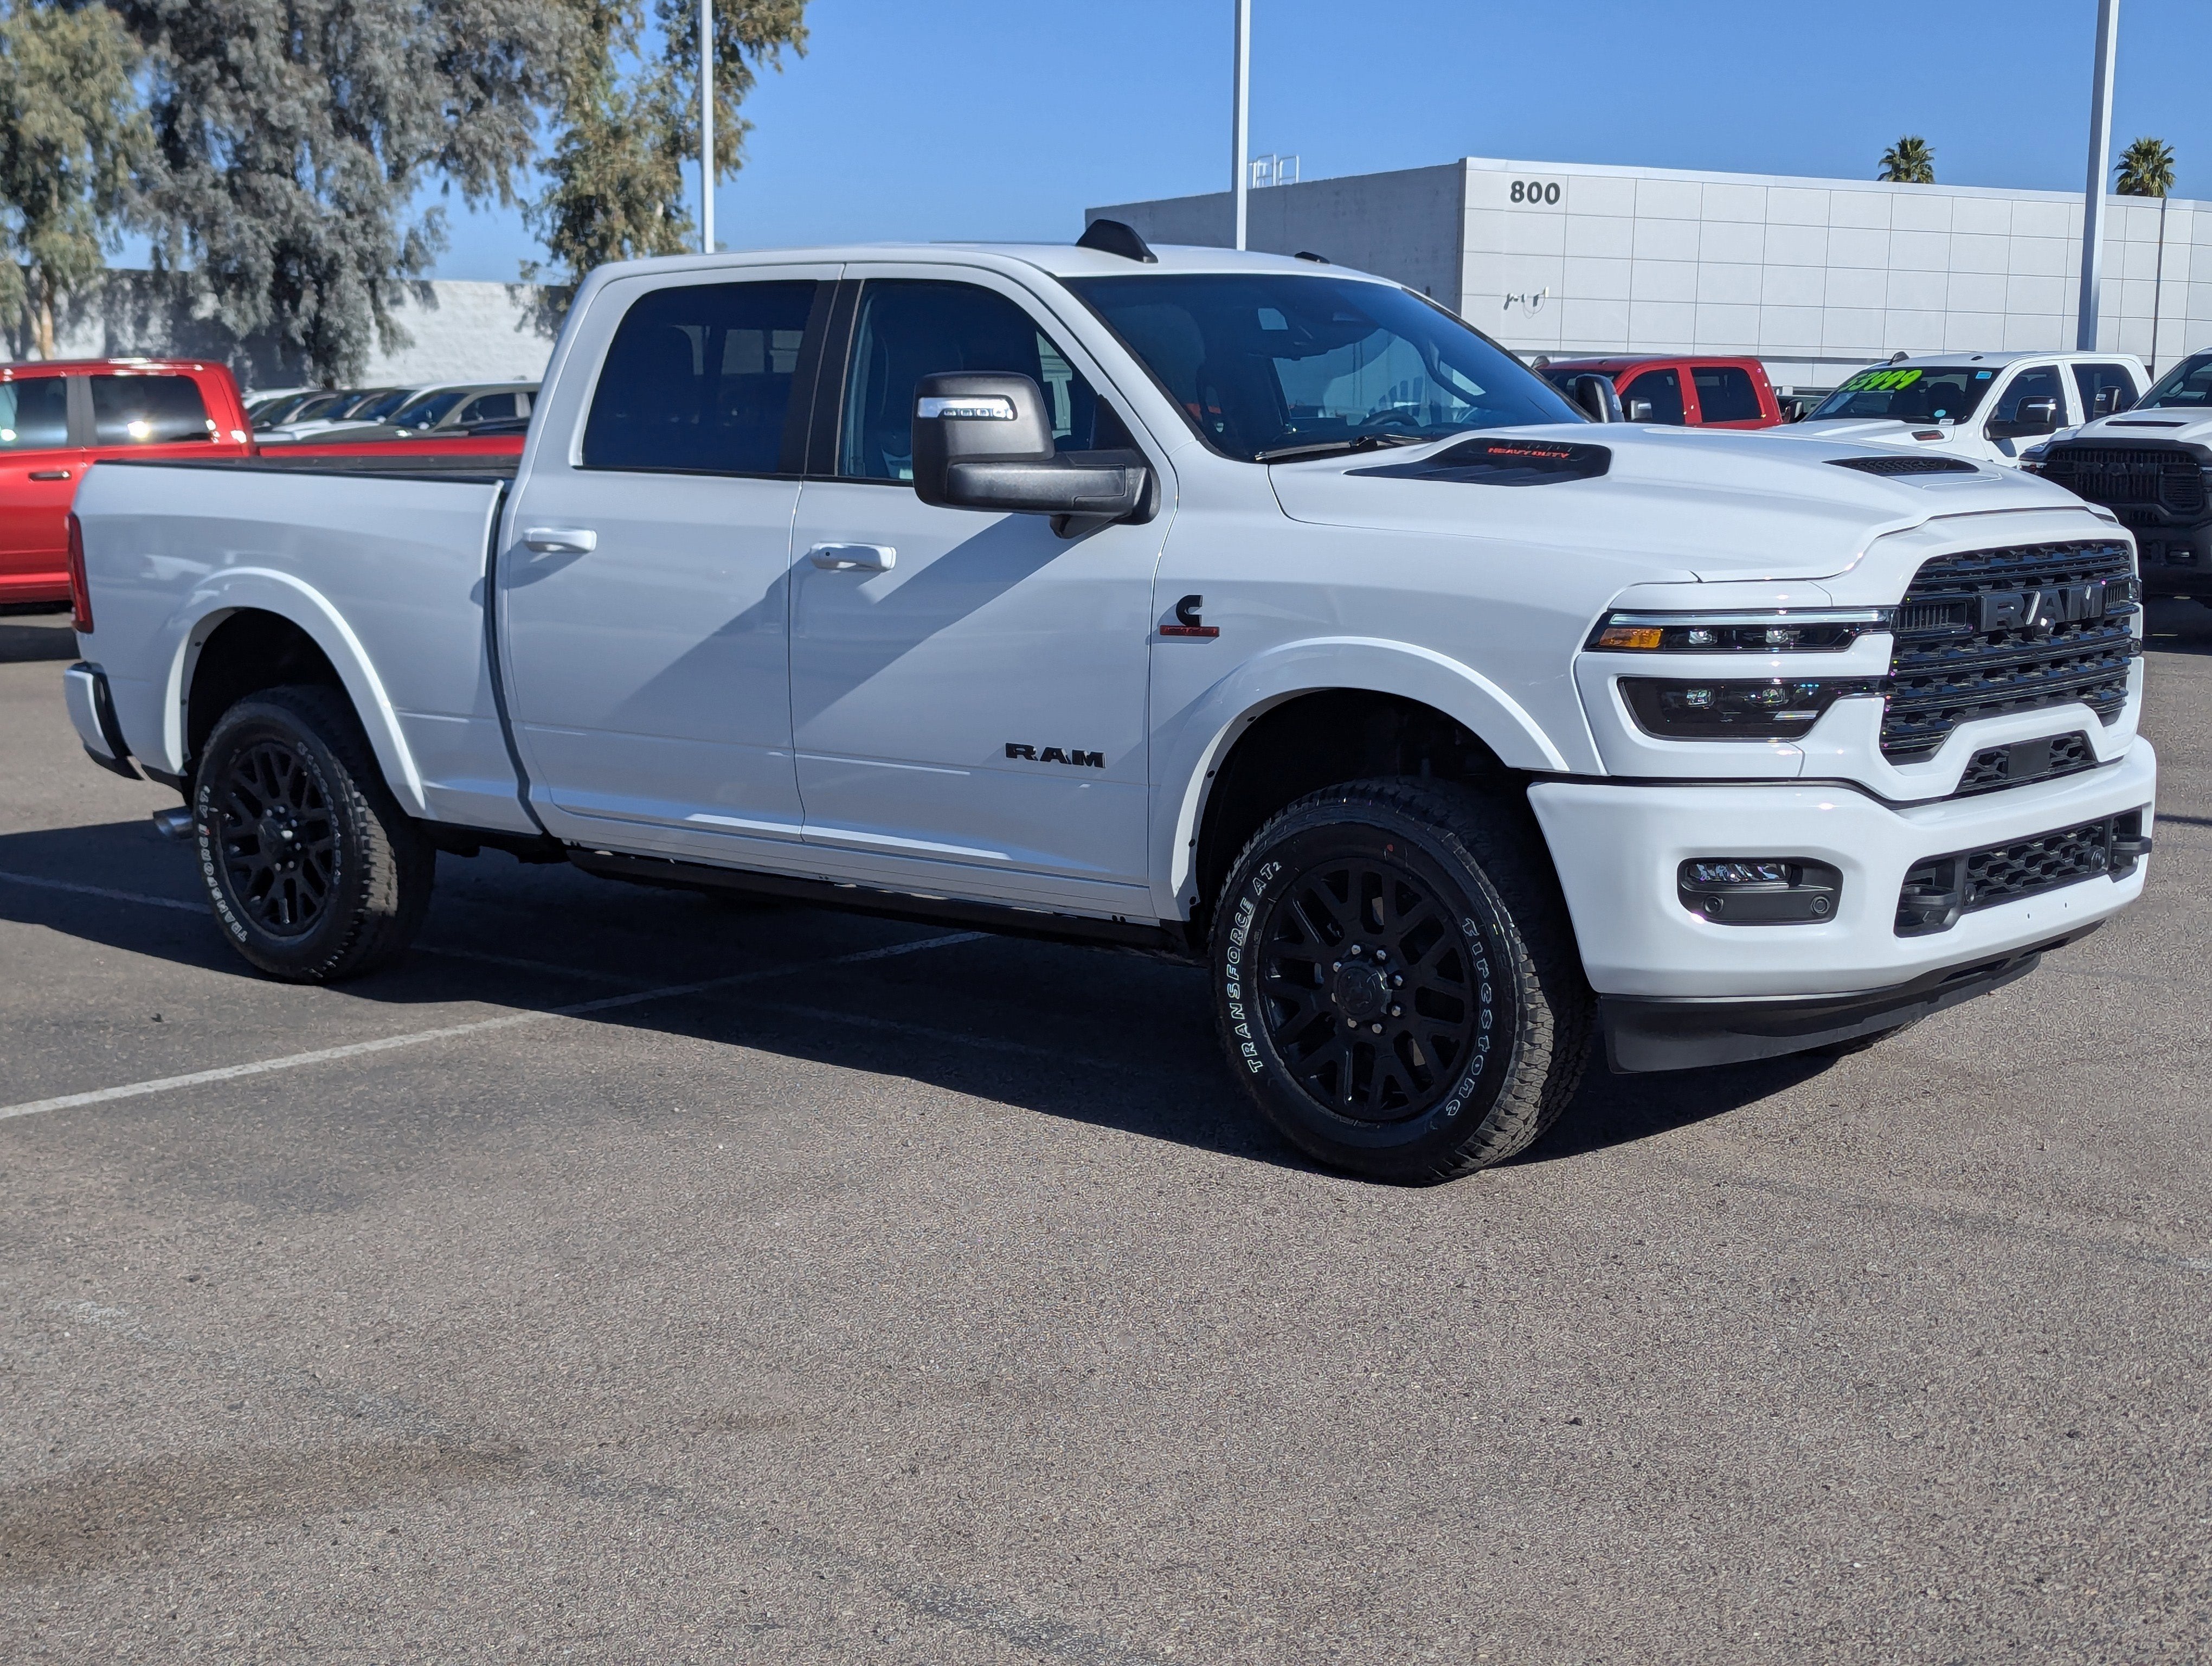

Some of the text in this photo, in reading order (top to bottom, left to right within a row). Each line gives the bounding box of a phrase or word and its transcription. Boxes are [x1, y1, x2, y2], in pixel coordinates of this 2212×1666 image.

[1510, 181, 1560, 205] 800
[1488, 447, 1570, 459] HEAVY DUTY
[1980, 584, 2103, 632] RAM
[1005, 742, 1106, 768] RAM
[1226, 896, 1264, 1074] TRANSFORCE
